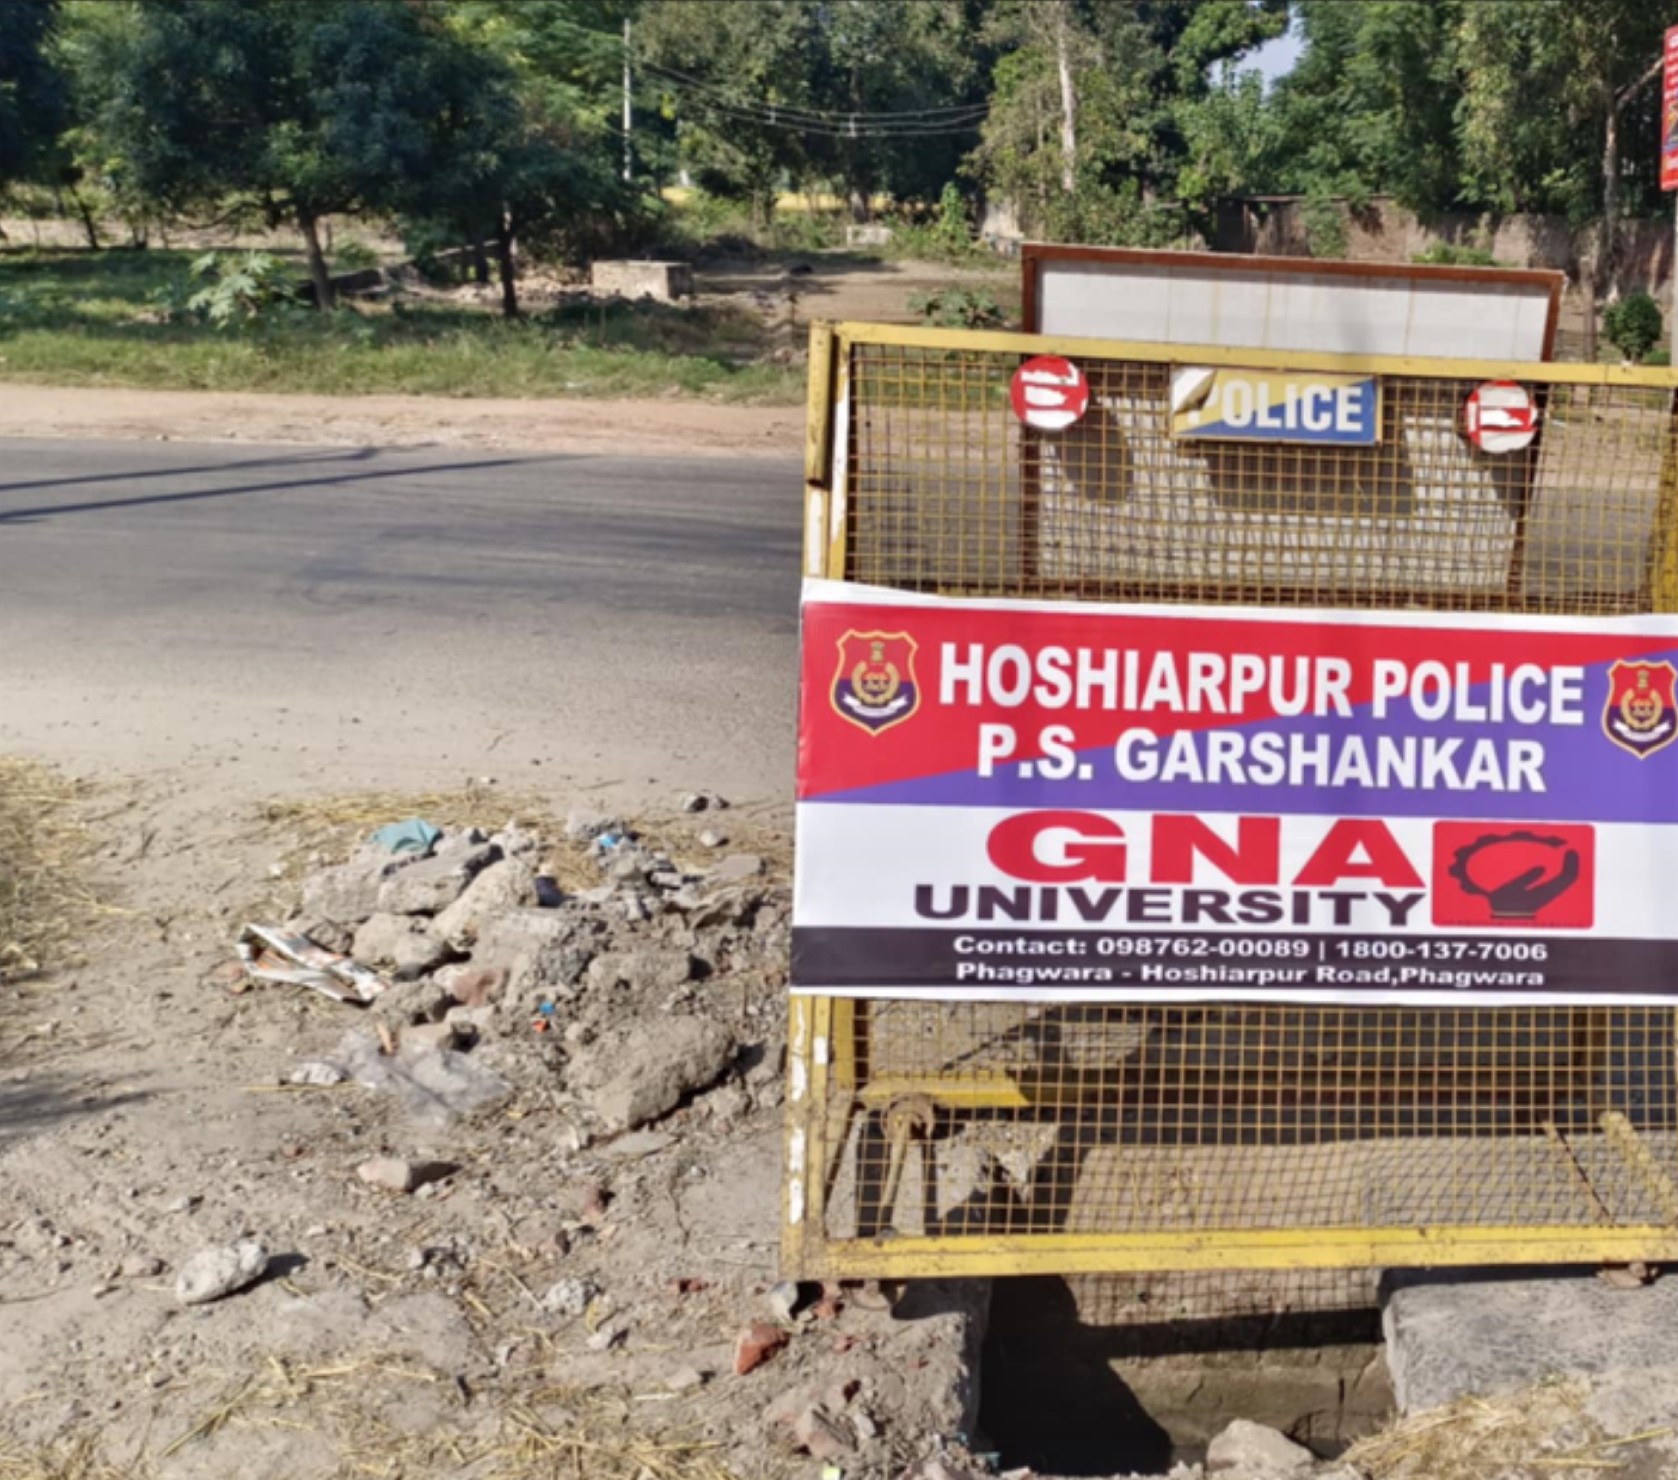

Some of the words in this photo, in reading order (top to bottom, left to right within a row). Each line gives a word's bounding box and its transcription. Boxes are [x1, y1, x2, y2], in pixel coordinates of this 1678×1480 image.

[939, 643, 1353, 717] HOSHIARPUR
[1373, 661, 1585, 724] POLICE
[977, 724, 1092, 781] P.S.
[1115, 728, 1545, 792] GARSHANKAR
[986, 811, 1426, 887] GNA
[914, 884, 1425, 925] UNIVERSITY
[954, 936, 1087, 955] Contact:
[1096, 937, 1309, 957] 098762-00089
[1335, 941, 1547, 960] 1800-137-7006
[957, 963, 1111, 984] Phagwara
[1141, 964, 1307, 985] Hoshiarpur
